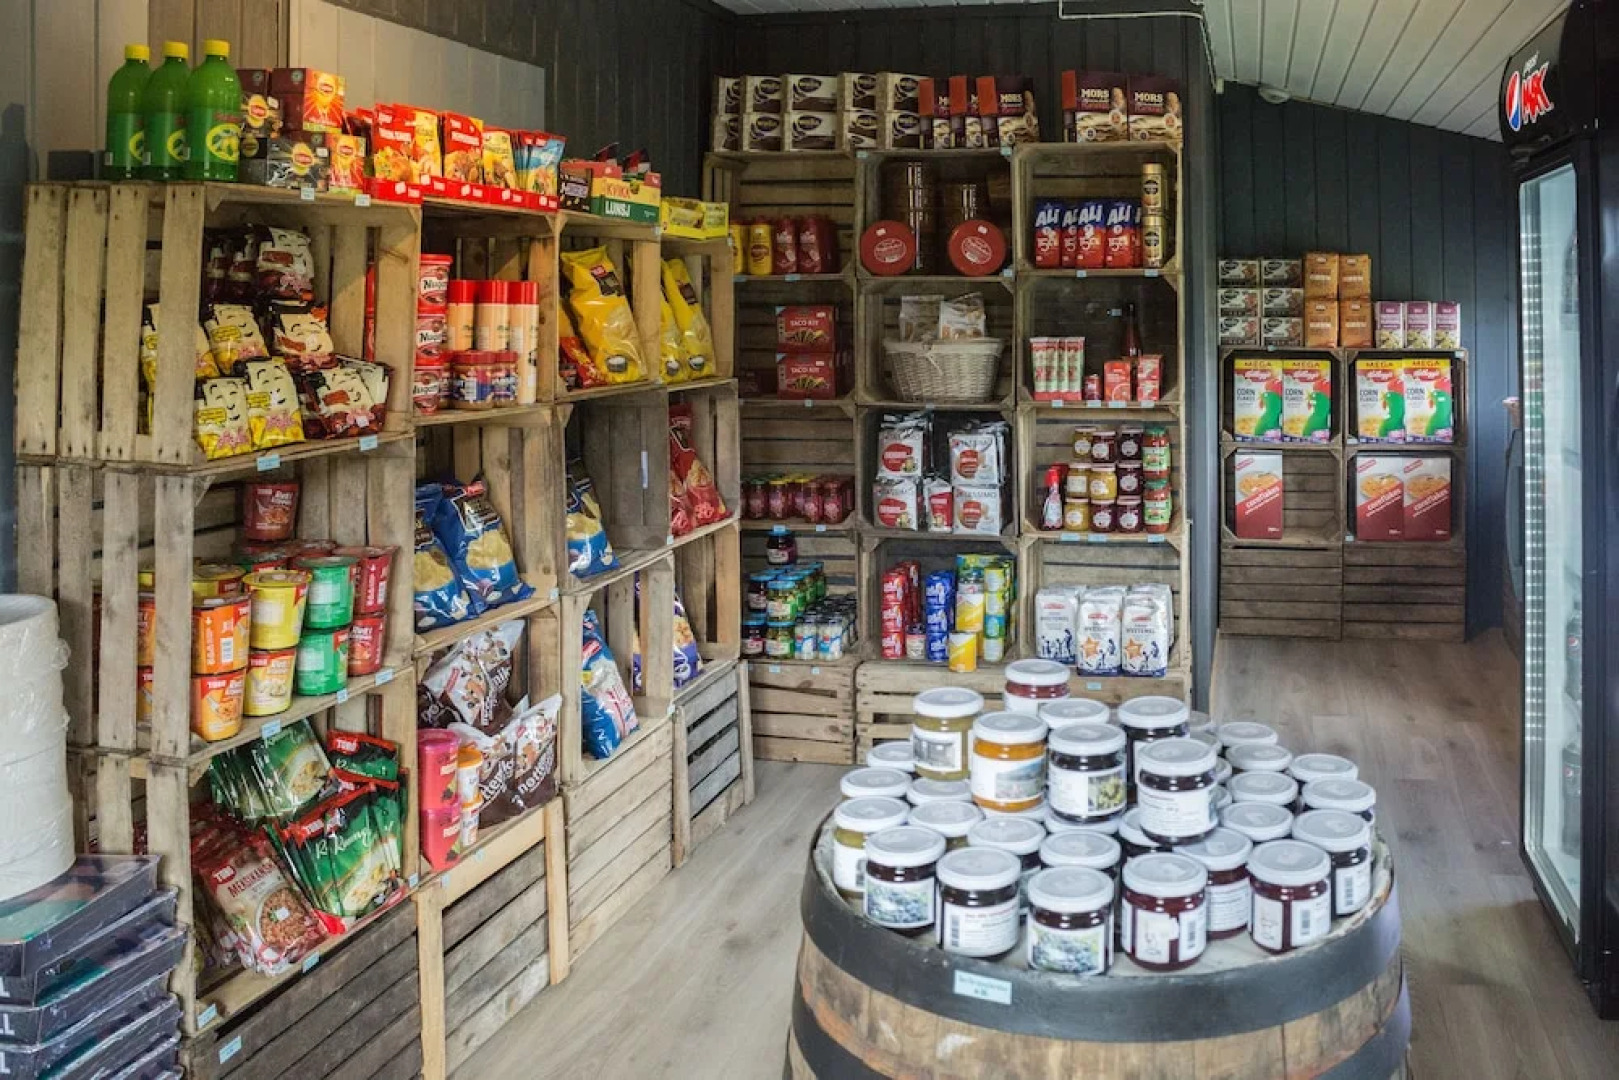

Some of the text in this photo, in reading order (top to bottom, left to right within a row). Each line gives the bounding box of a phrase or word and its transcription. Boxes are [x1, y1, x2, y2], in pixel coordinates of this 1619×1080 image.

[1000, 94, 1022, 103] MORS
[1081, 89, 1110, 100] MORS
[1134, 92, 1163, 103] MORS
[1035, 208, 1061, 227] ALI
[1078, 205, 1103, 226] ALI
[1106, 205, 1132, 226] ALI
[1237, 388, 1256, 396] CORN
[1285, 388, 1304, 396] CORN
